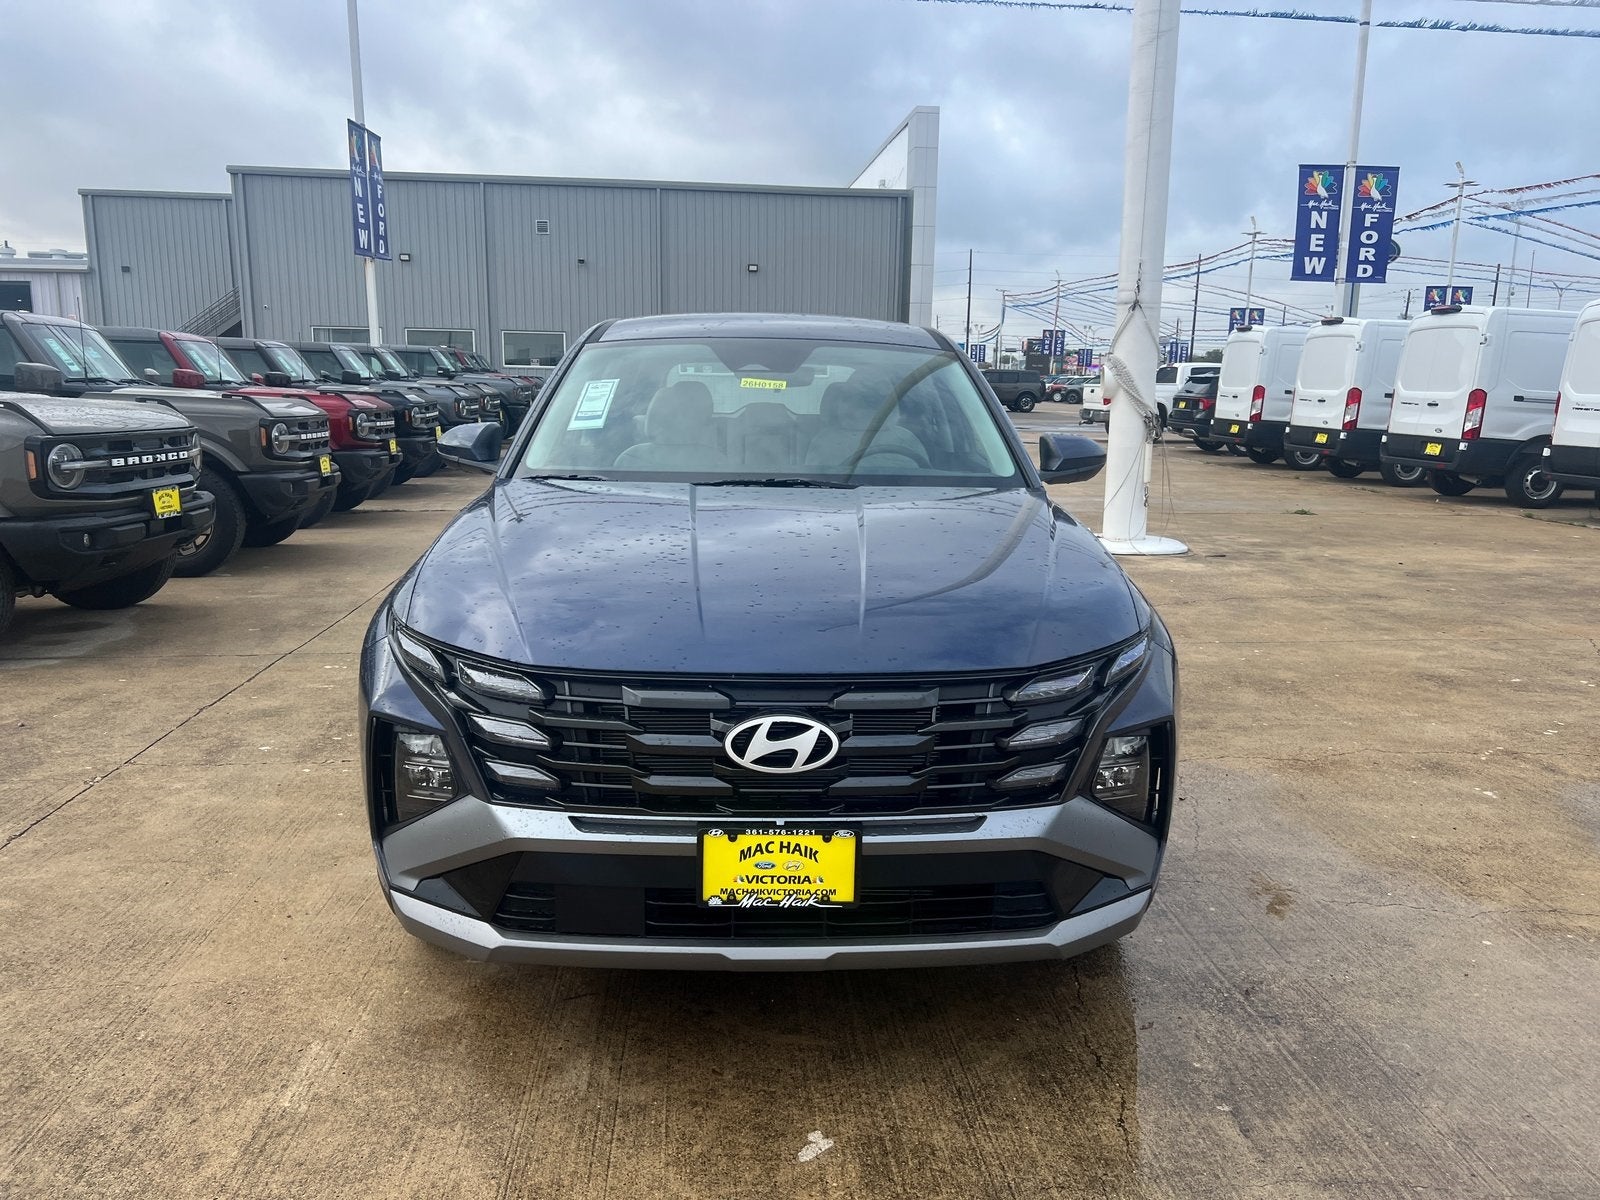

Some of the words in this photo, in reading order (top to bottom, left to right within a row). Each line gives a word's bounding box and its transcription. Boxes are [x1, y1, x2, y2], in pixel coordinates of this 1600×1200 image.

[354, 176, 368, 249] NEW
[377, 184, 385, 254] FORD
[1304, 211, 1328, 275] NEW
[1356, 213, 1379, 278] FORD
[742, 380, 784, 389] 26H0158
[111, 451, 188, 467] BRONCO
[739, 841, 775, 863] MAC
[779, 841, 819, 864] HAIK
[745, 875, 812, 885] VICTORIA
[738, 893, 778, 908] Mac
